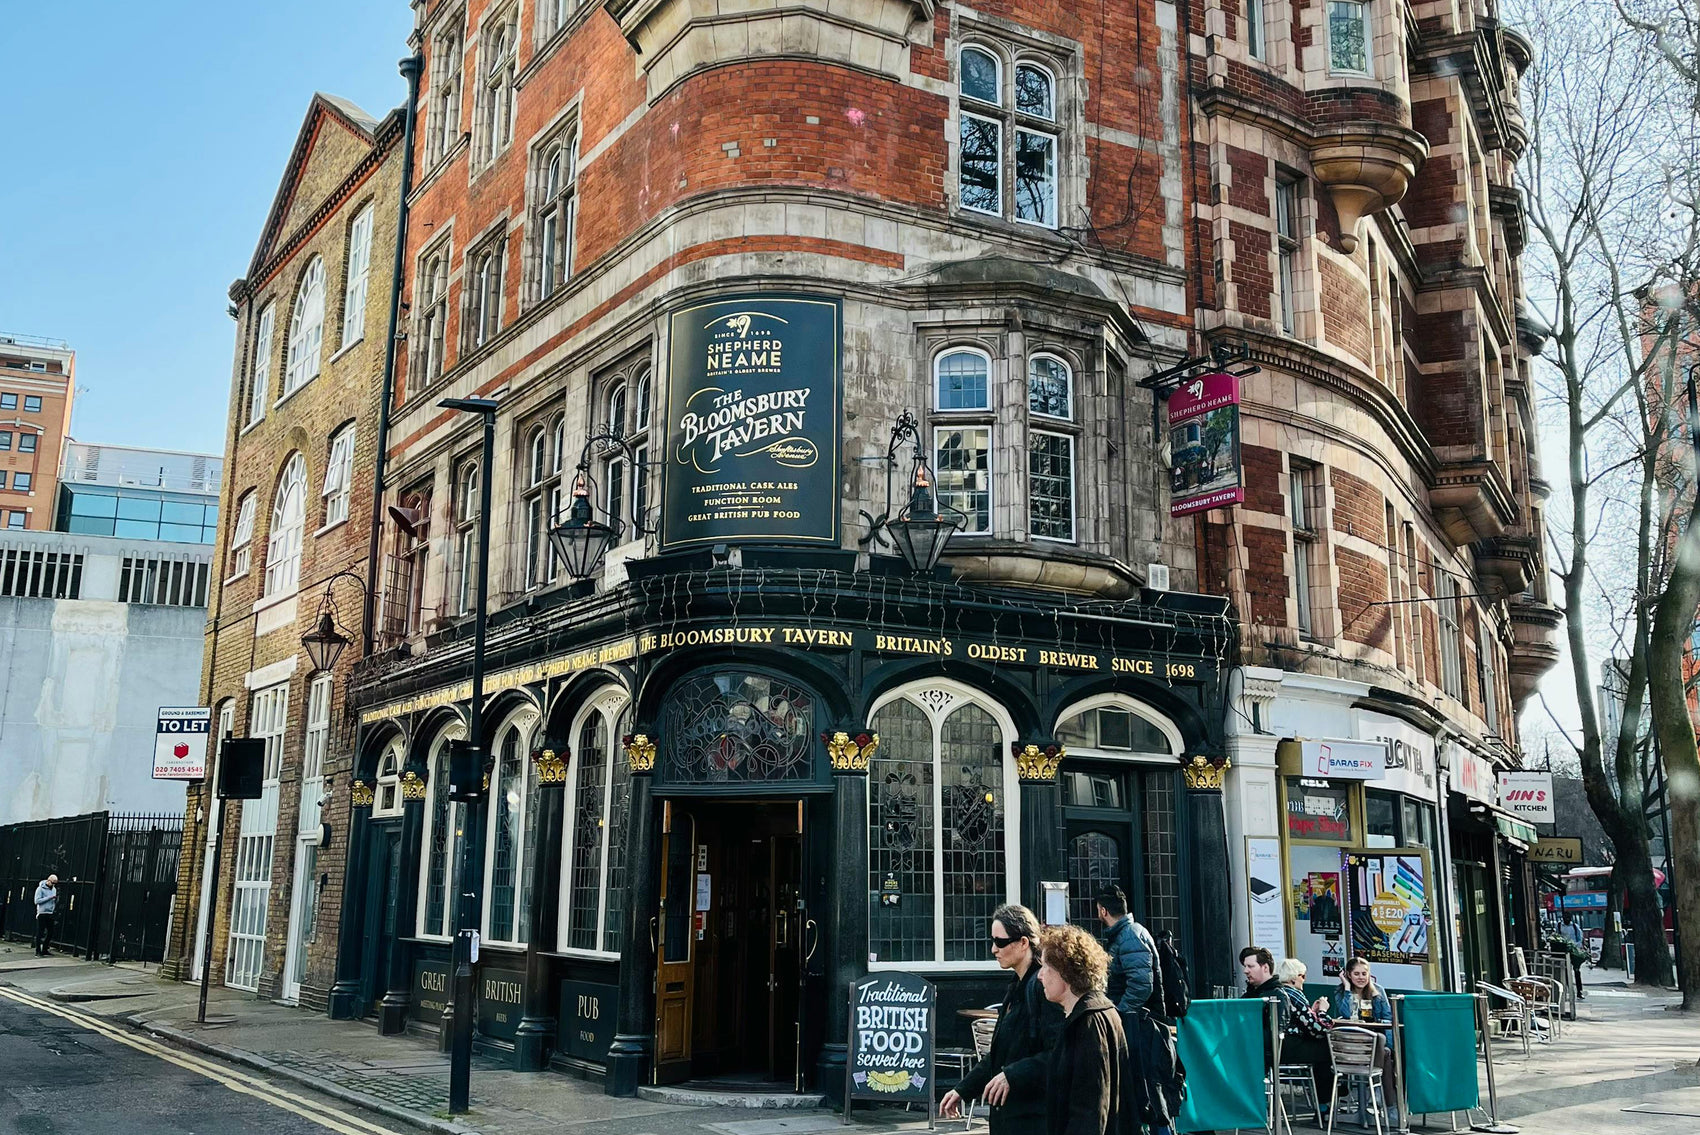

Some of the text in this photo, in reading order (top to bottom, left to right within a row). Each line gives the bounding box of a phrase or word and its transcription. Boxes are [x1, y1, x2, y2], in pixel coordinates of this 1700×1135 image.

[707, 340, 782, 354] SHEPHERD
[707, 351, 781, 370] NEAME
[712, 389, 743, 409] THE
[1169, 394, 1233, 420] SHEPHERD NEAME
[680, 388, 811, 450] BLOOMSBURY
[705, 411, 806, 463] TAVERN
[691, 482, 798, 494] TRADITIONAL CASK ALES
[704, 496, 781, 507] FUNCTION ROOM
[1171, 491, 1236, 513] BLOOMSBURY TAVERN
[688, 510, 801, 522] GREAT BRITISH PUB FOOD
[572, 652, 598, 670] NEAME
[598, 641, 634, 663] BREWERY
[639, 627, 1195, 679] THE BLOOMSBURY TAVERN BRITAIN'S OLDEST BREWER SINCE 1698
[160, 720, 208, 732] TO LET
[1506, 790, 1546, 802] JIN'S
[1514, 804, 1548, 812] KITCHEN
[1534, 847, 1573, 859] NARU
[1371, 907, 1379, 918] 4
[1386, 907, 1403, 919] £20
[1371, 950, 1409, 960] BASEMENT
[421, 971, 447, 992] GREAT
[857, 979, 928, 1003] Traditional
[485, 979, 522, 1004] BRITISH
[577, 994, 599, 1020] PUB
[856, 1005, 929, 1032] BRITISH
[579, 1030, 595, 1043] FOOD
[859, 1030, 923, 1053] FOOD
[856, 1052, 925, 1068] served here
